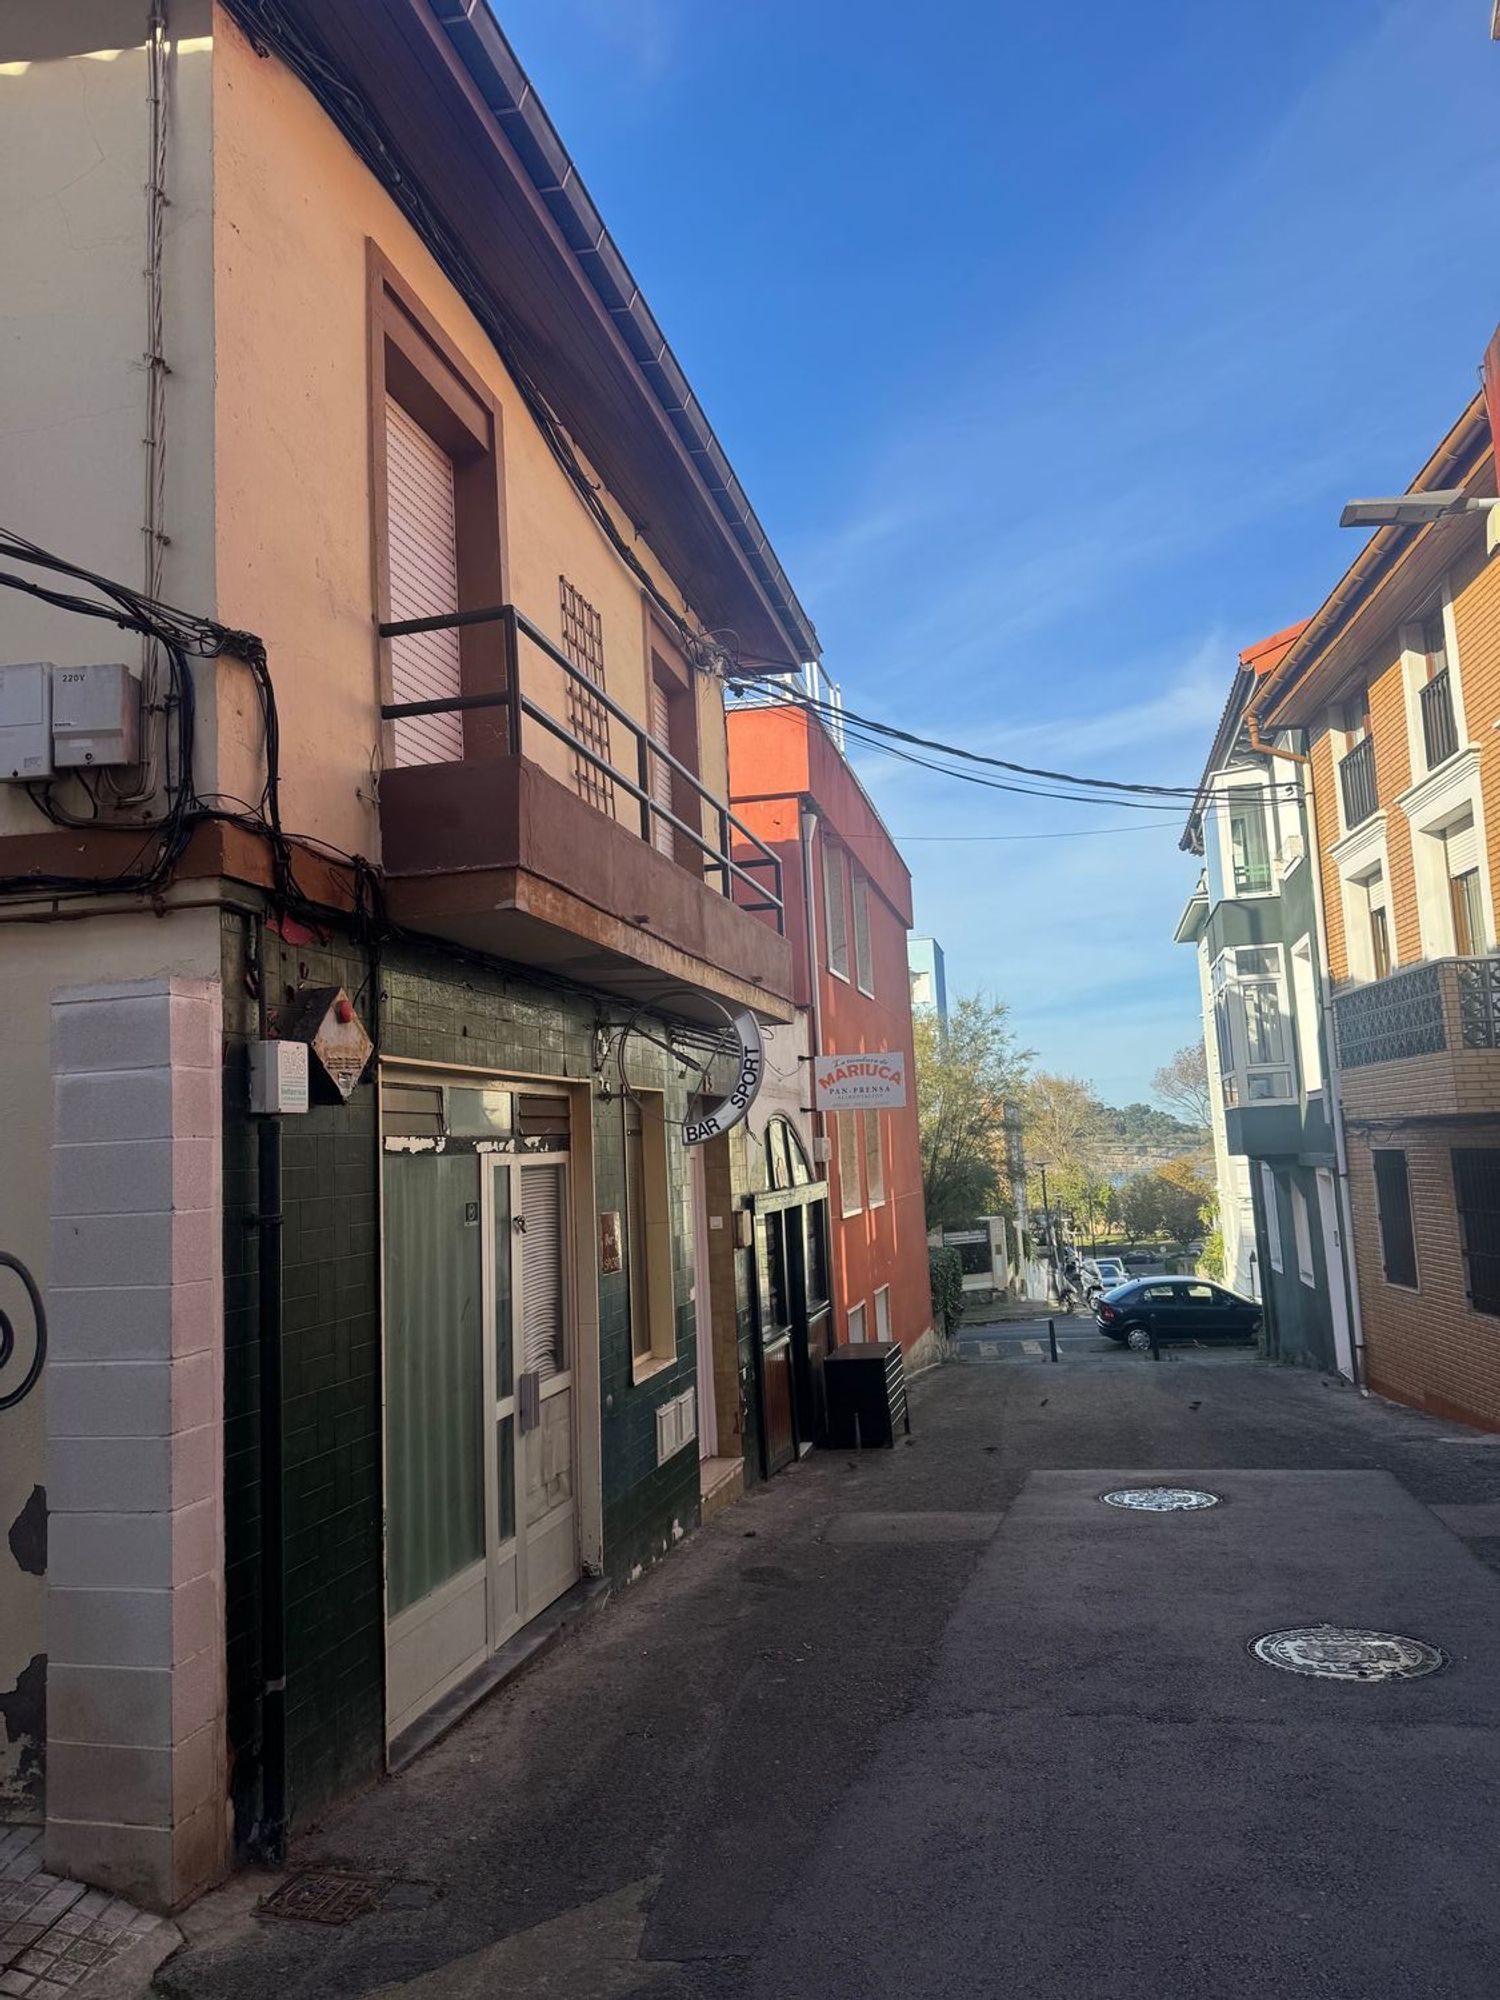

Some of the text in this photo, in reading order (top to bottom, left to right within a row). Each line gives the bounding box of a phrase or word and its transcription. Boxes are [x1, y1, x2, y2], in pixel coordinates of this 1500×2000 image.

[62, 674, 85, 683] 220V
[818, 1063, 901, 1089] MARIUCA
[686, 1046, 759, 1142] BAR SPORT
